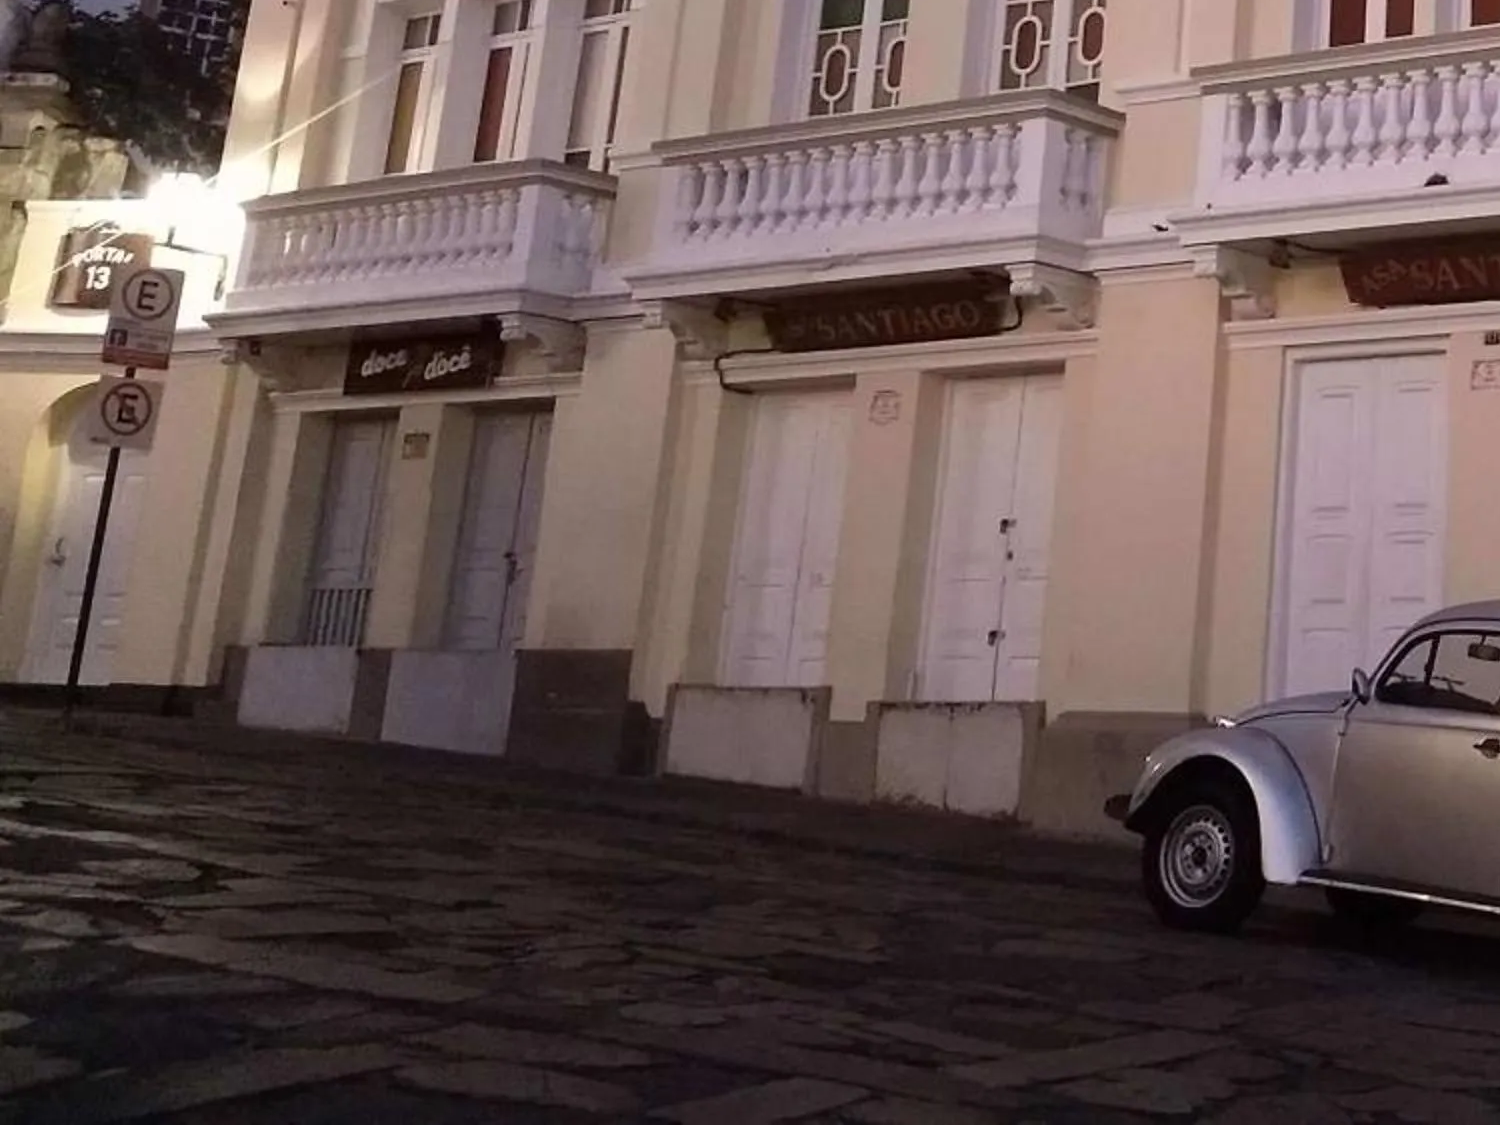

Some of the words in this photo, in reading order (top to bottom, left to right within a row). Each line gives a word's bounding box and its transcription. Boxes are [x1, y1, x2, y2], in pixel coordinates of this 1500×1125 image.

[85, 266, 112, 290] 13
[137, 280, 160, 312] E
[815, 299, 981, 341] SANTIAGO
